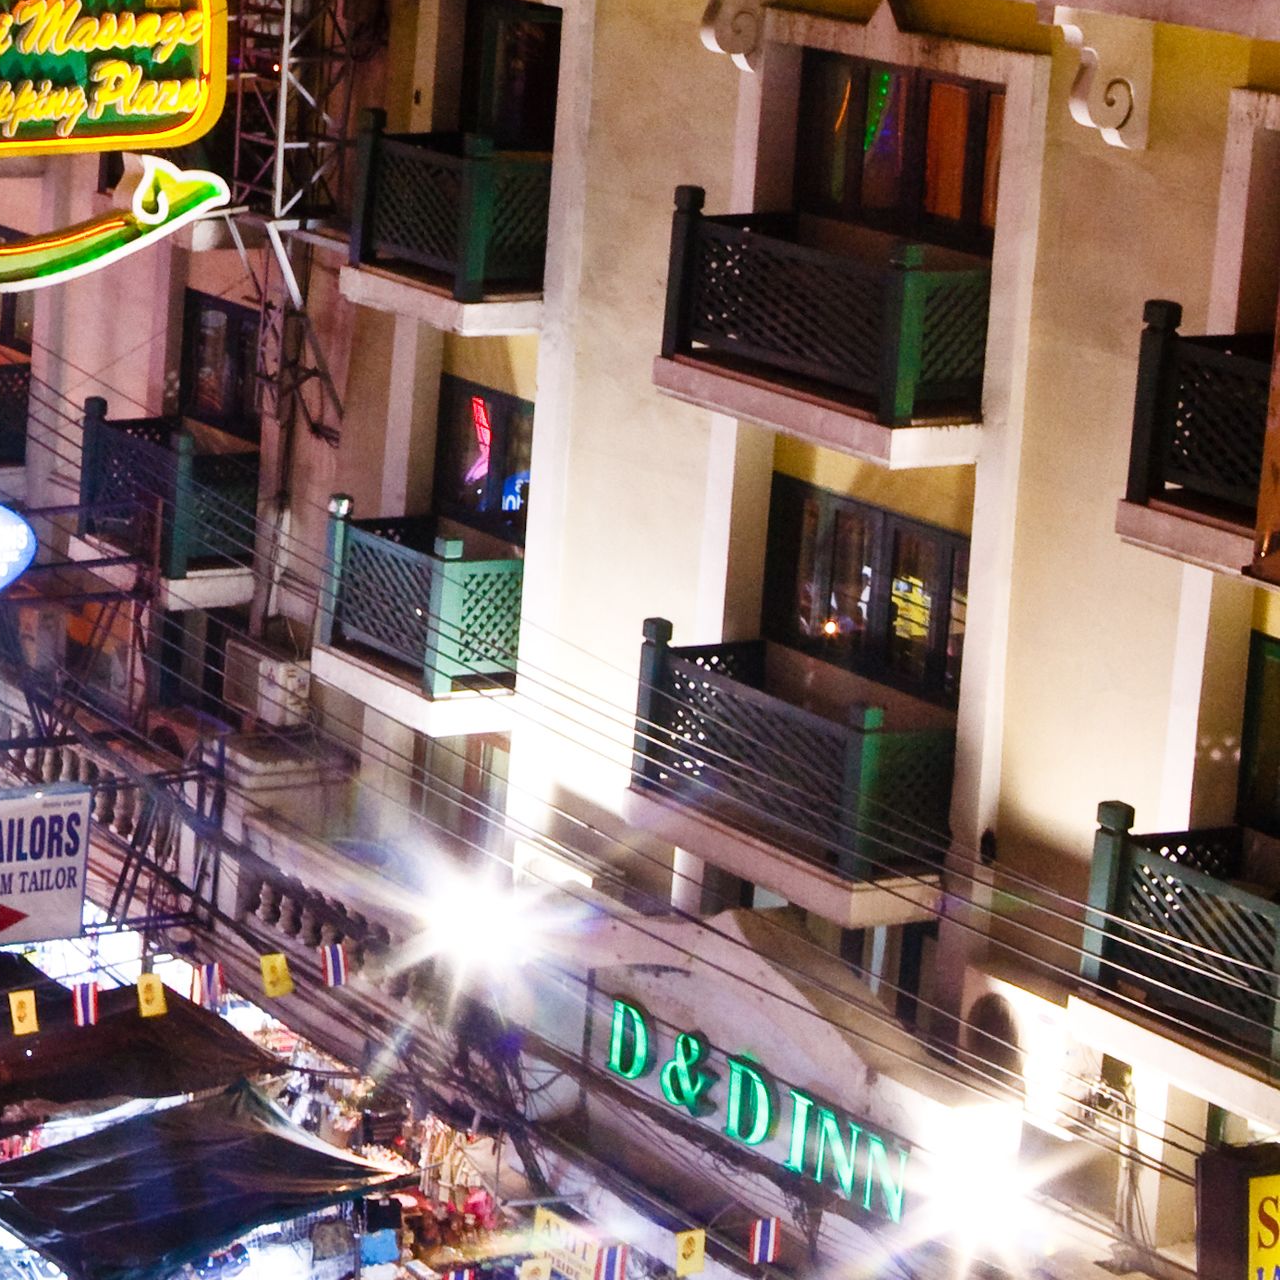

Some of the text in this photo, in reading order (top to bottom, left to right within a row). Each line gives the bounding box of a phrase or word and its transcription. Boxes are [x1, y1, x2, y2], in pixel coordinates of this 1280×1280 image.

[86, 57, 209, 119] Plaza
[18, 866, 78, 894] TAILOR
[783, 1087, 909, 1225] INN
